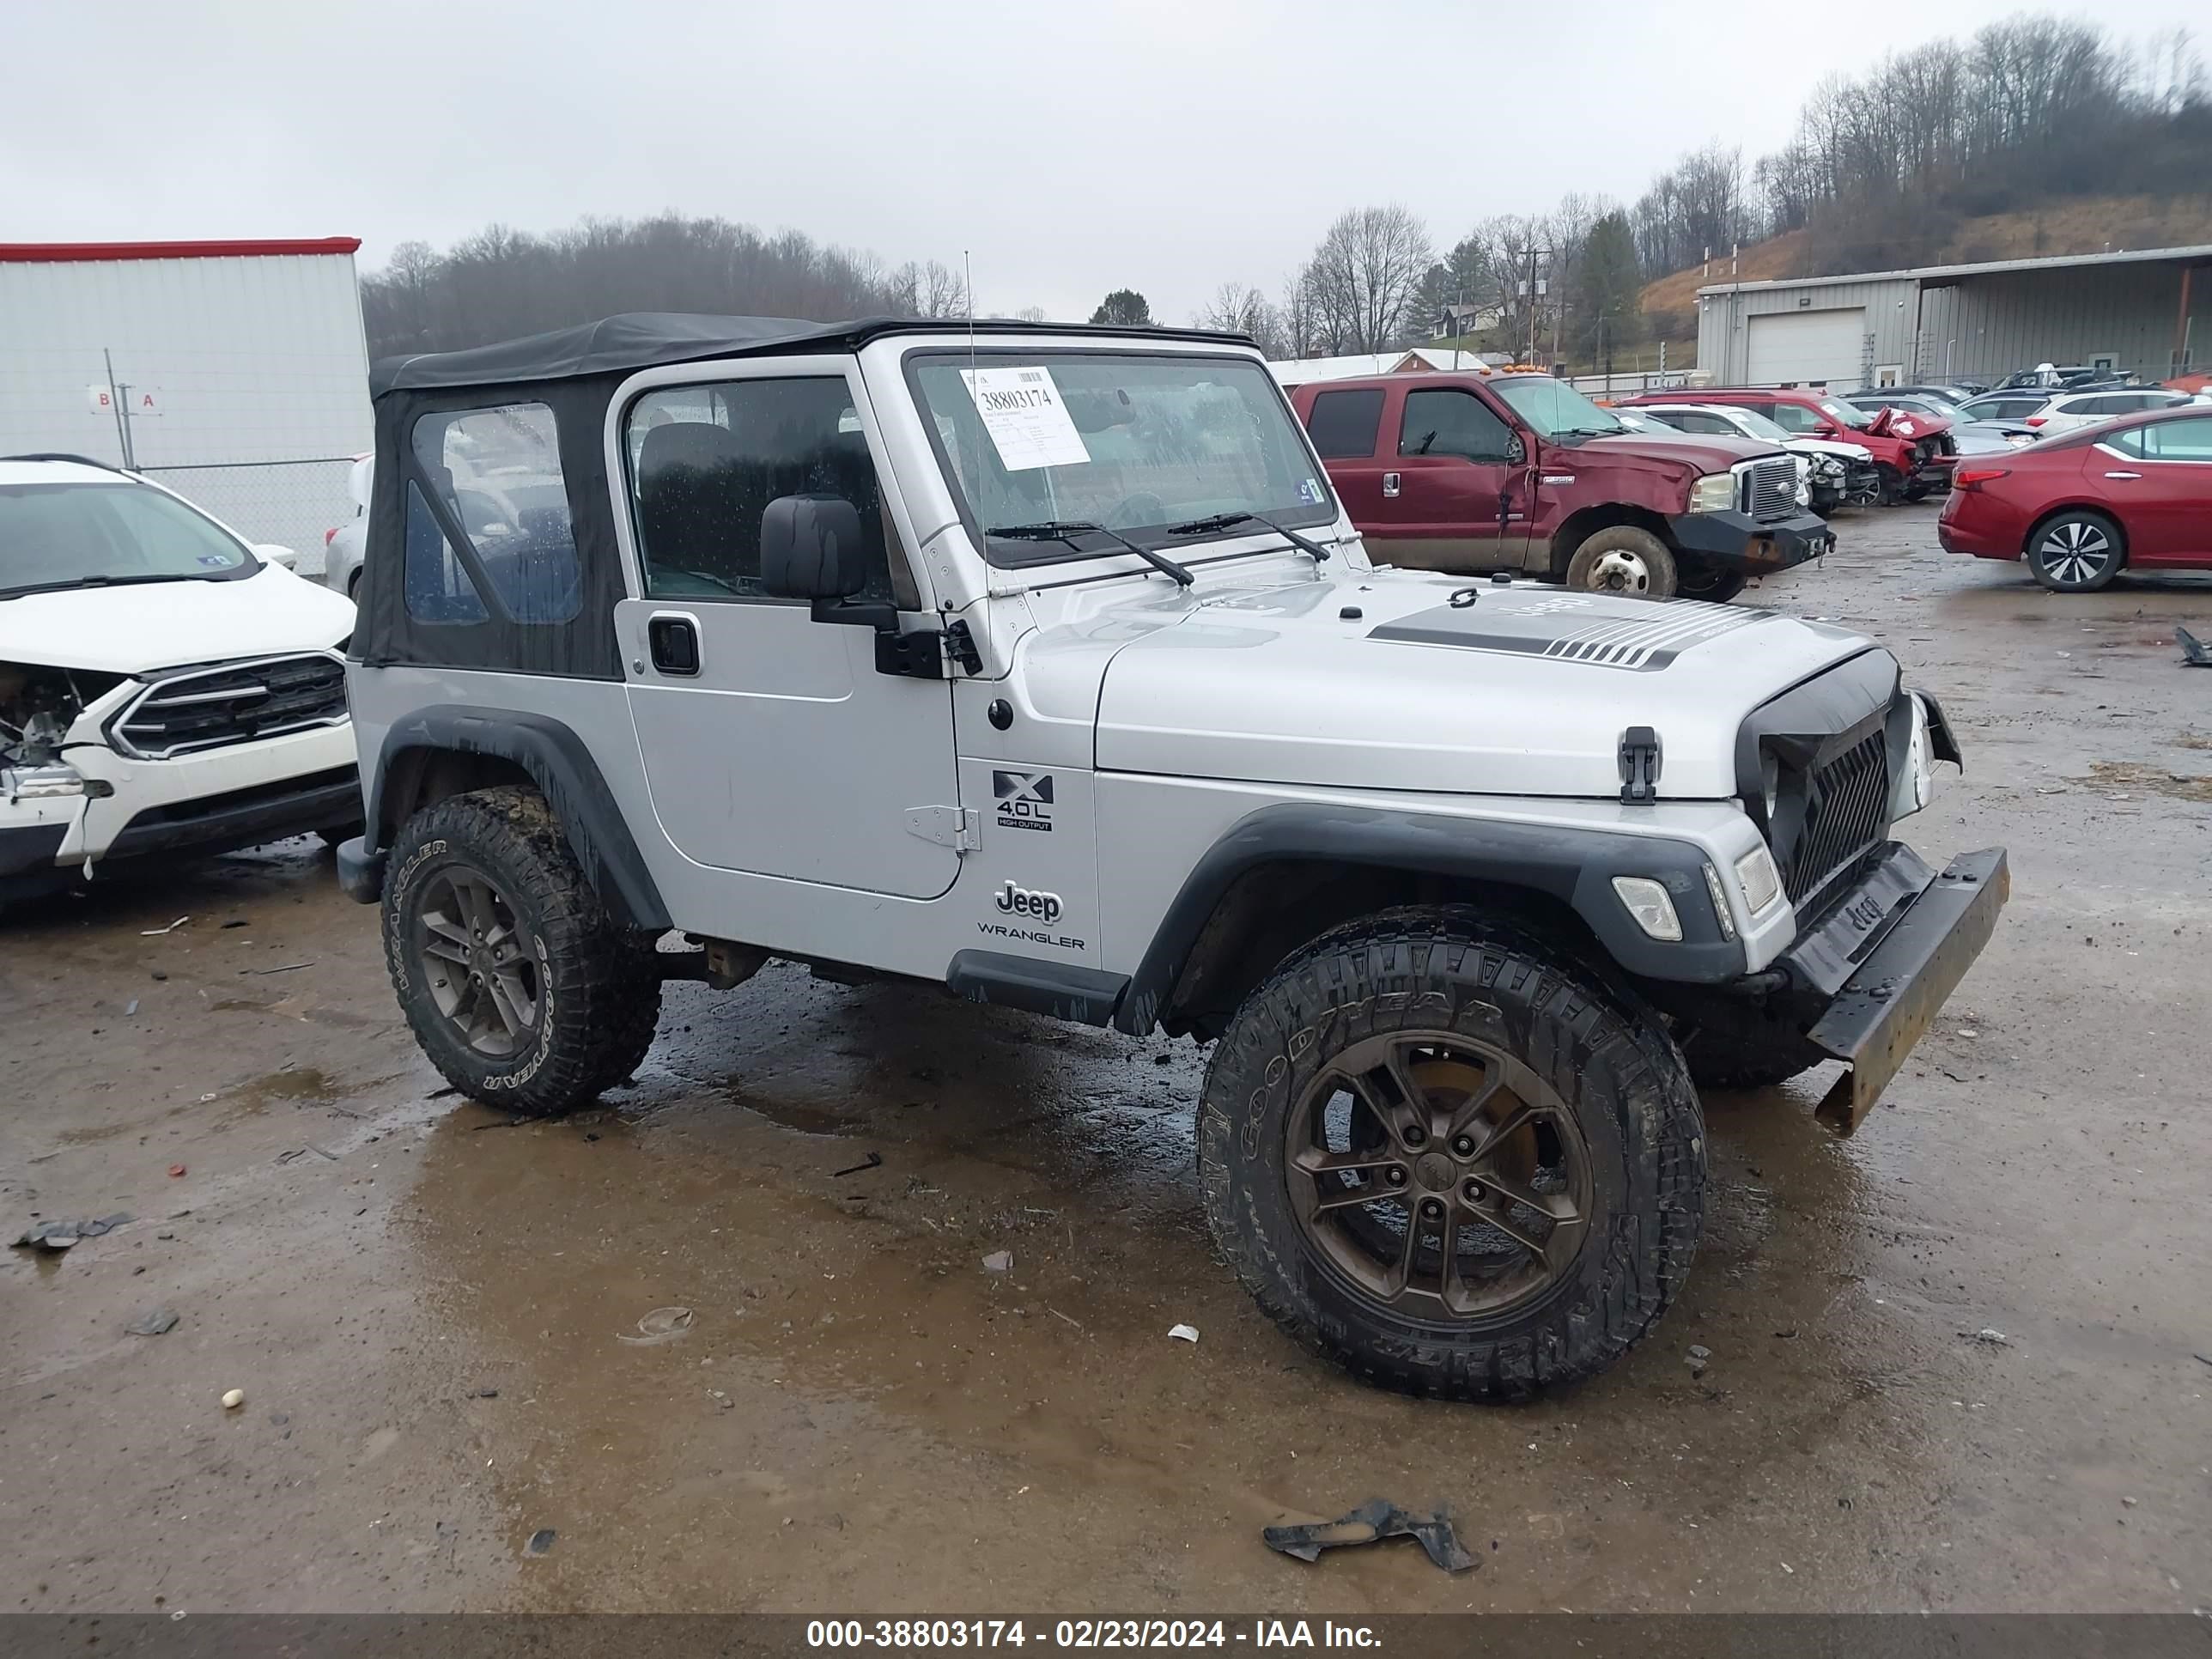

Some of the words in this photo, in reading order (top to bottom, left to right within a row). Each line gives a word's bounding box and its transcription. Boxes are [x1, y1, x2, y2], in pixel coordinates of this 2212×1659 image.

[100, 392, 110, 405] B
[143, 394, 155, 407] A
[981, 388, 1053, 411] 38803174
[999, 772, 1049, 802] X
[999, 818, 1018, 828] HIGH
[1018, 820, 1049, 830] OUTPUT
[389, 839, 447, 991] WRANGLER
[996, 883, 1061, 924] Jeep
[1845, 896, 1886, 931] Jeep
[976, 921, 1085, 951] WRANGLER
[483, 933, 556, 1091] GOODYEAR
[1241, 991, 1504, 1162] GOODYEAR
